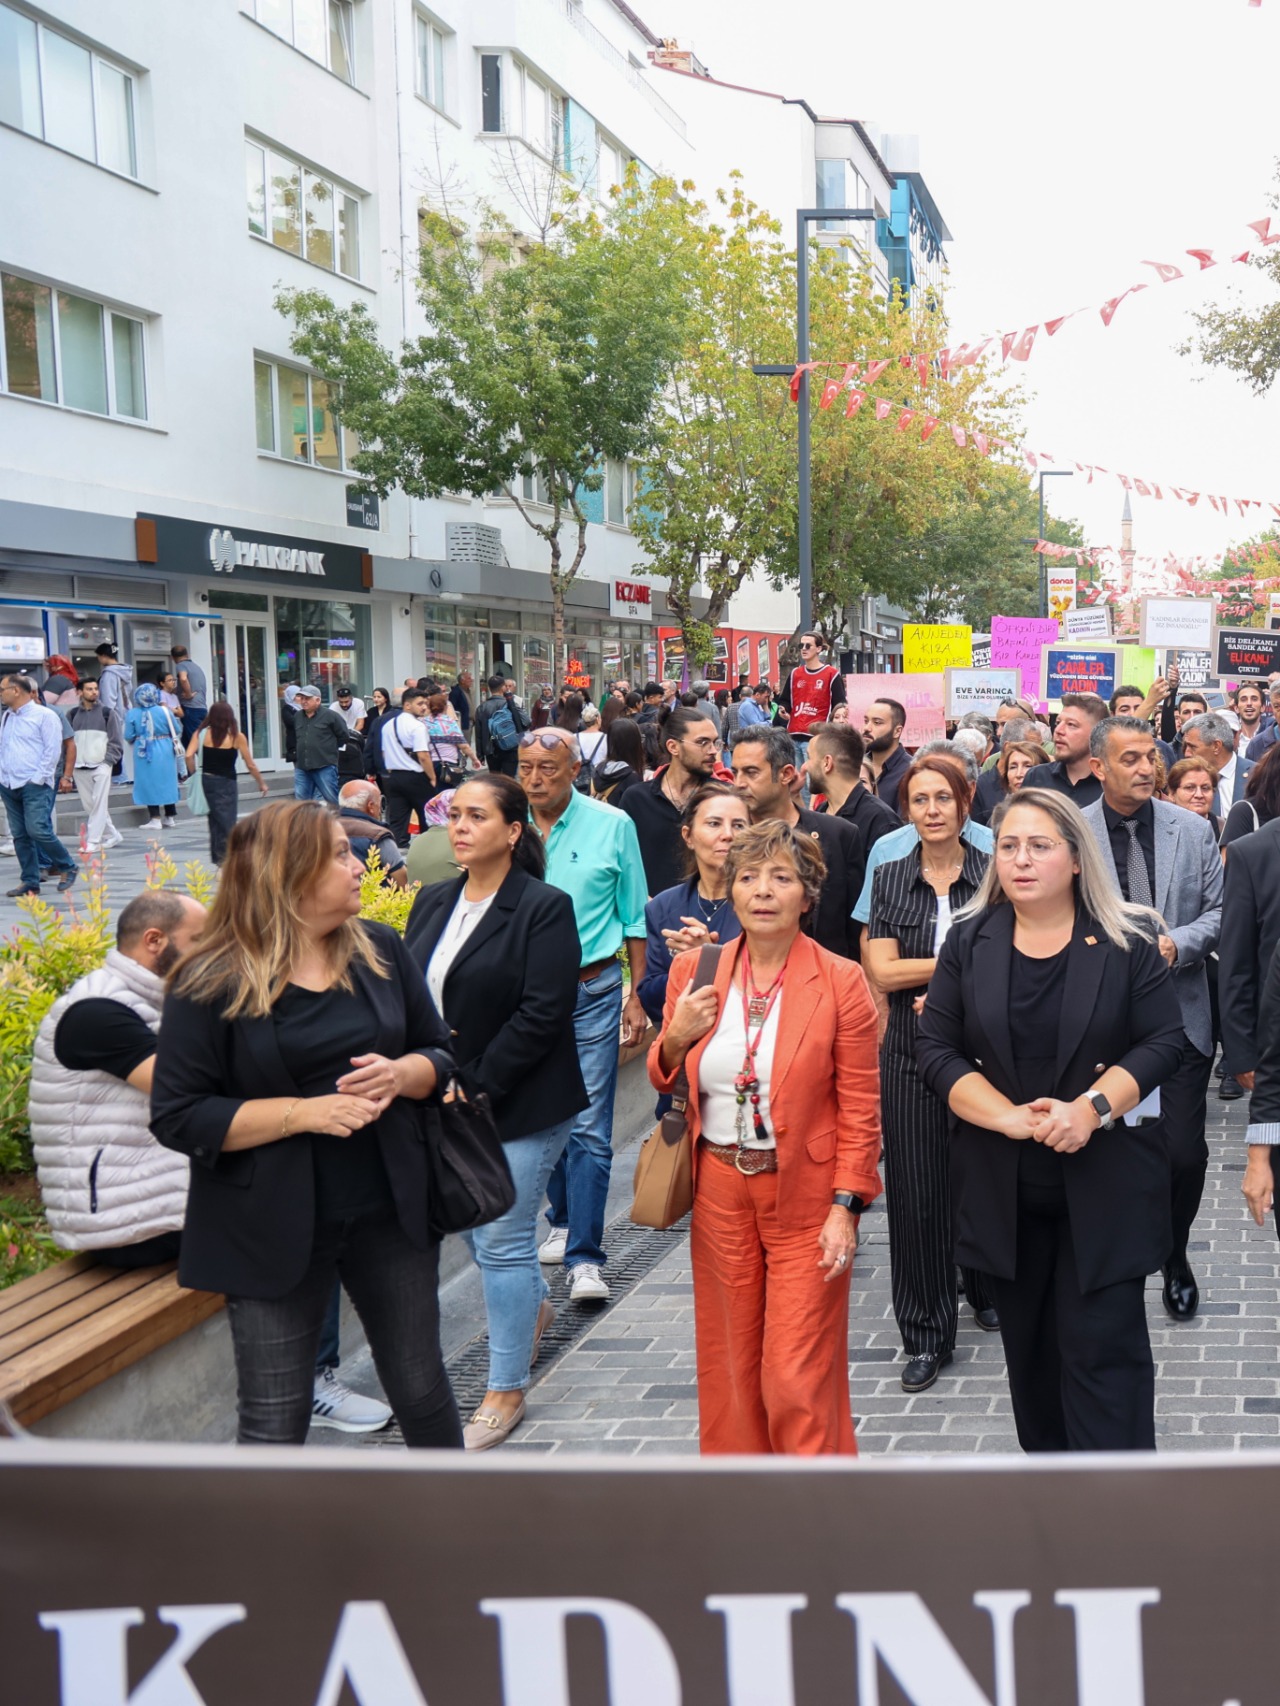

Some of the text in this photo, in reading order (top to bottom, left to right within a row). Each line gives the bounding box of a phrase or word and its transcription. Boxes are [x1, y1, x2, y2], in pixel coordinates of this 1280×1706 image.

[235, 540, 326, 576] HALKBANK
[615, 580, 652, 604] ECZANE
[1228, 643, 1255, 651] SANDIK
[1238, 638, 1278, 647] DELİKANLI
[1057, 660, 1105, 675] CANİLER
[975, 687, 1013, 695] VARINCA
[1062, 679, 1098, 692] KADIN
